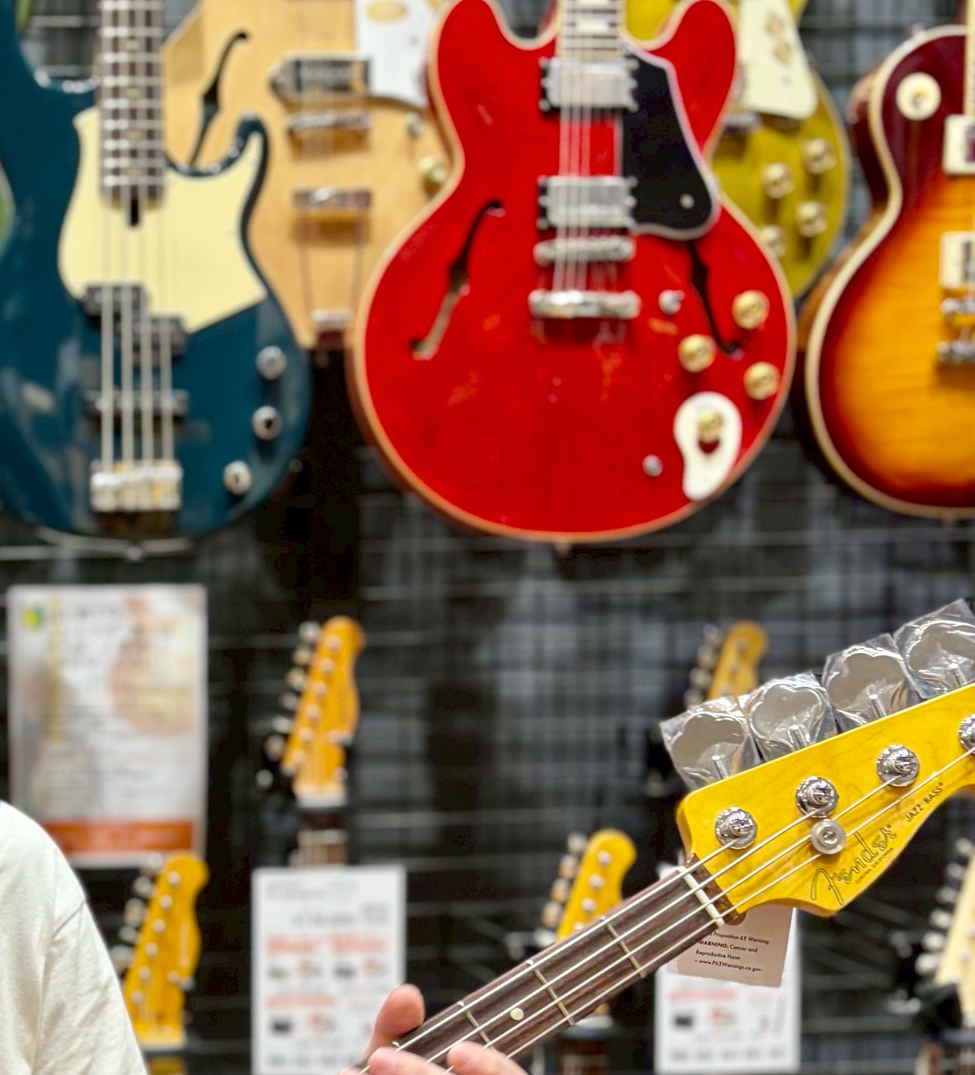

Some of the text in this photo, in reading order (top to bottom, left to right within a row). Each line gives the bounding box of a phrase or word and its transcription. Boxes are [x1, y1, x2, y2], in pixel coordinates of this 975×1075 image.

[905, 785, 943, 822] JAZZ BASS
[809, 826, 897, 906] Fender
[696, 949, 726, 958] Reproductive
[699, 940, 729, 949] WARNING:
